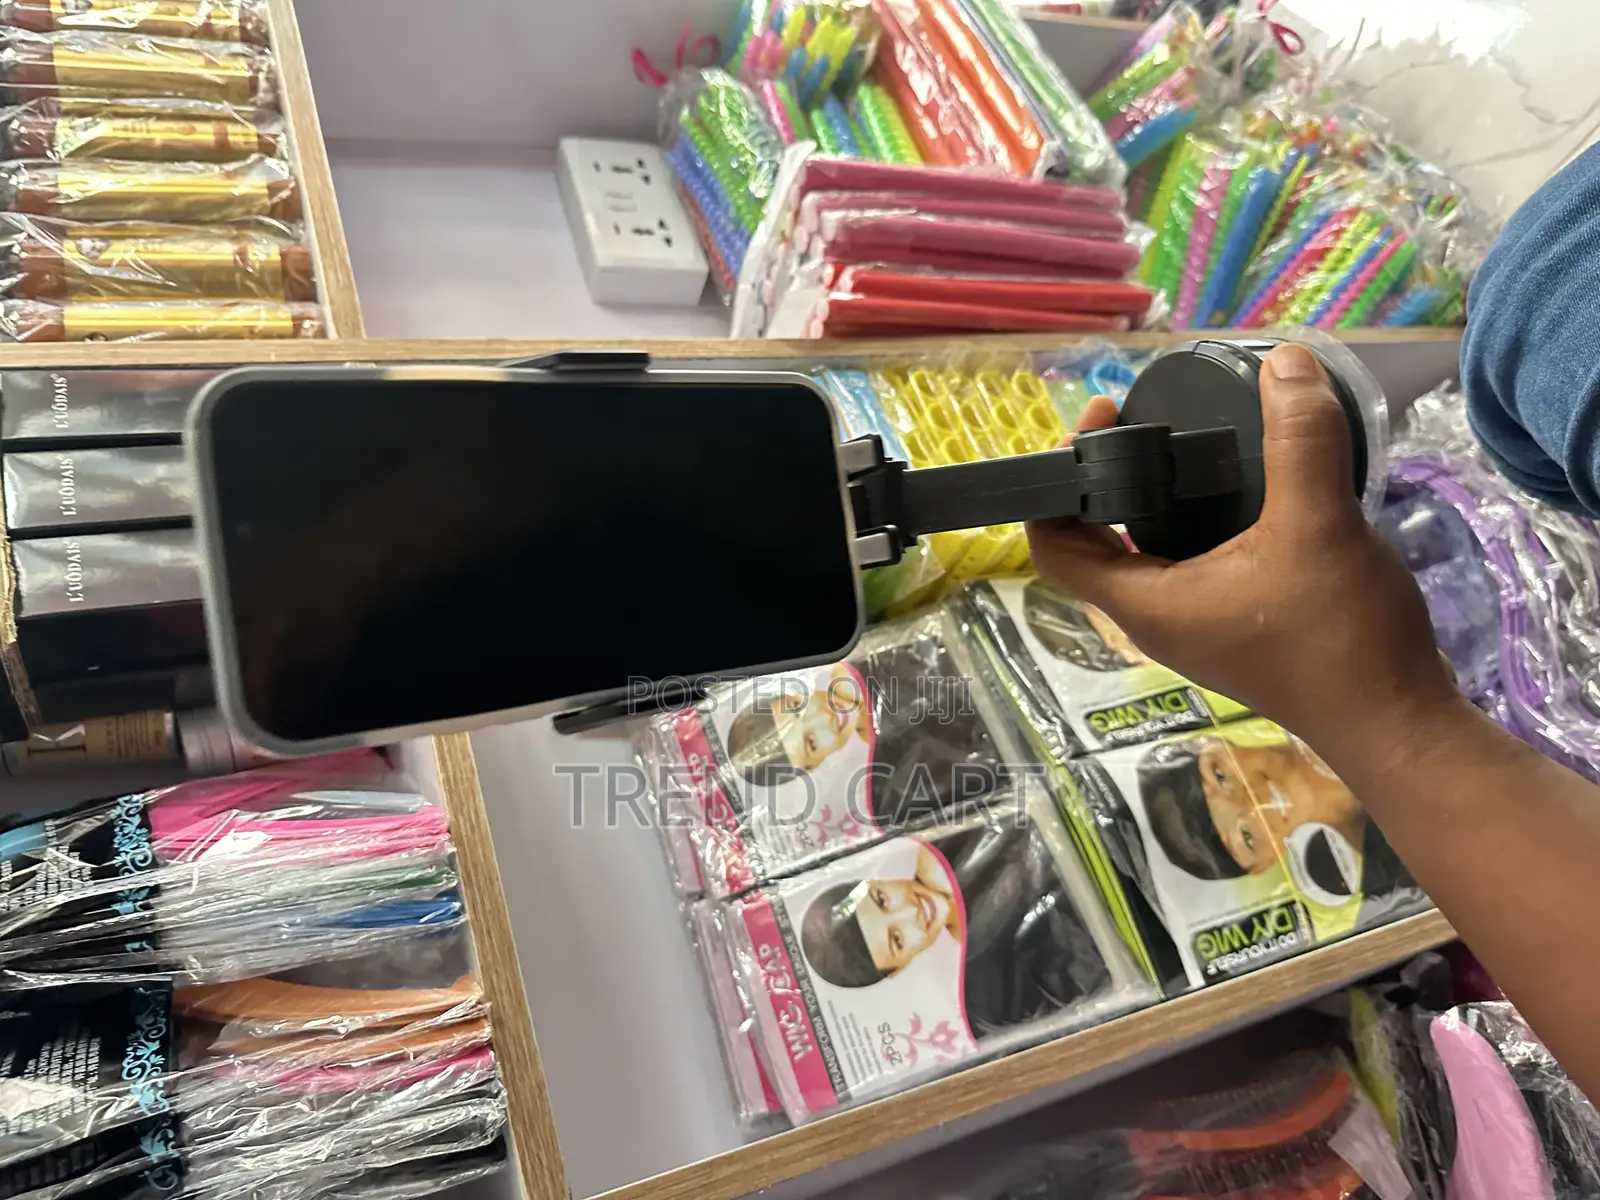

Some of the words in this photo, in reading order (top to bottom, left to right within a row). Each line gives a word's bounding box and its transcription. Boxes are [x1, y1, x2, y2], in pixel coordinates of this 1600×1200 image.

[1088, 704, 1145, 733] WIG
[1147, 691, 1190, 718] DIY
[1195, 923, 1249, 960] WIG
[1252, 907, 1295, 942] DIY
[1278, 932, 1296, 946] DO
[1205, 943, 1265, 976] YOURSELF
[777, 1003, 814, 1061] WIG
[878, 1022, 903, 1066] 2PCS
